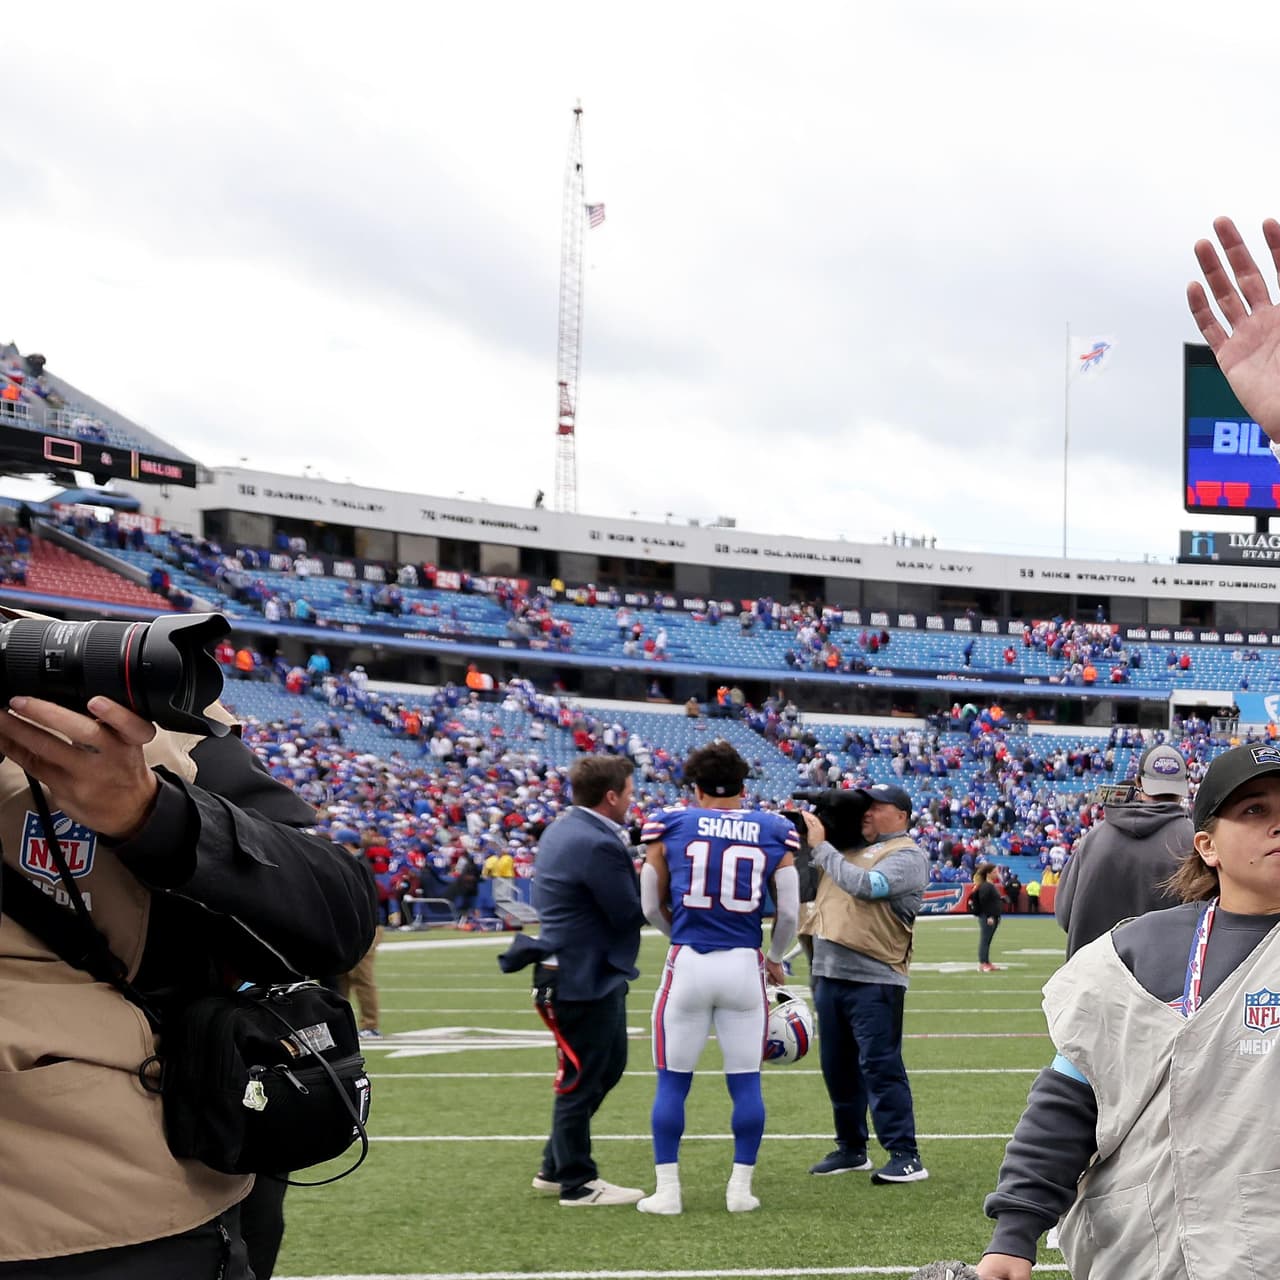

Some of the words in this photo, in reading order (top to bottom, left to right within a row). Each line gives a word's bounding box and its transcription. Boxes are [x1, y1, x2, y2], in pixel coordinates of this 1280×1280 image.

[896, 560, 934, 571] MARV
[940, 563, 975, 574] LEVY
[1041, 570, 1071, 580] MIKE
[1076, 573, 1136, 584] STRATTON
[1151, 576, 1167, 586] 44
[1173, 578, 1215, 588] ELBERT
[1218, 580, 1277, 590] DUBENION
[697, 816, 761, 843] SHAKIR
[681, 839, 768, 914] 10
[1247, 1006, 1280, 1028] NFL
[1238, 1038, 1276, 1056] MED
